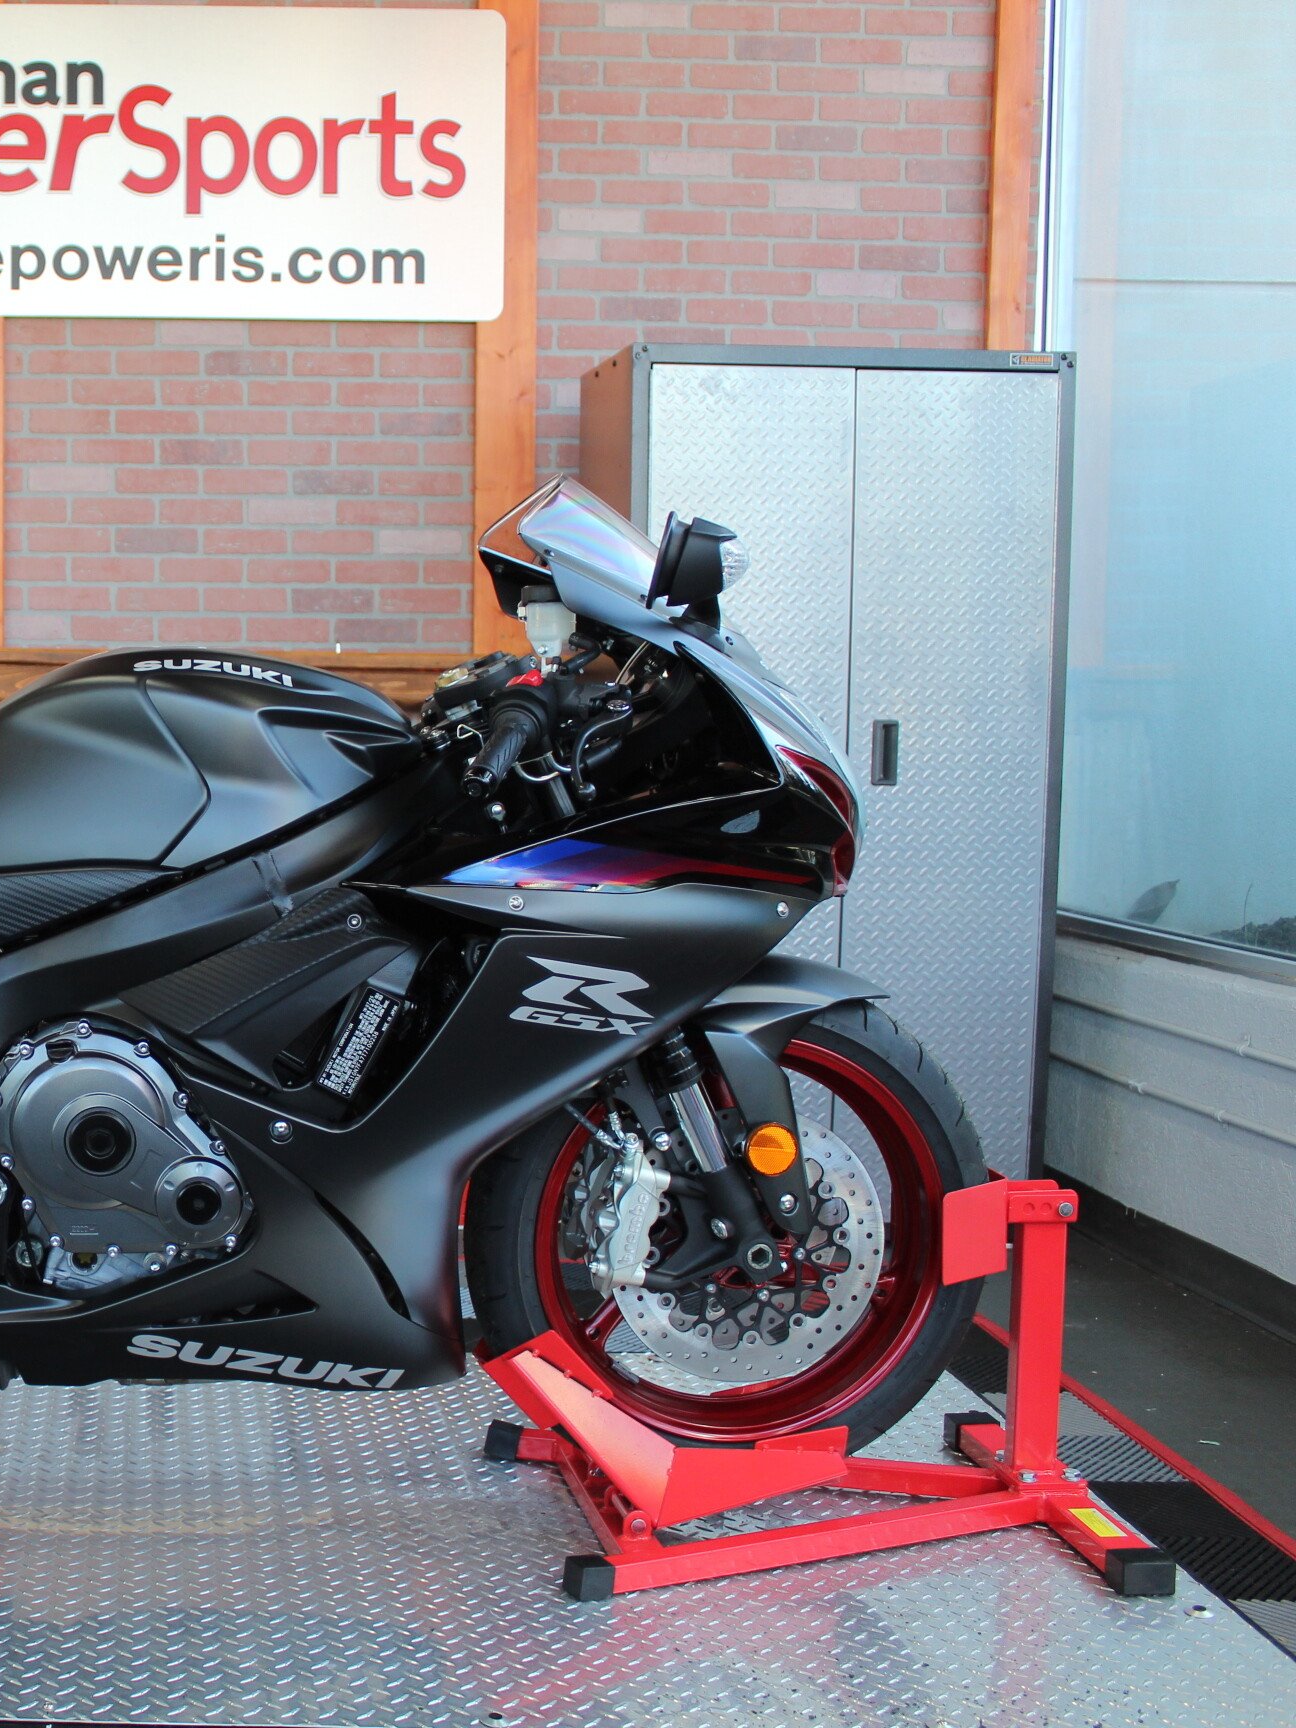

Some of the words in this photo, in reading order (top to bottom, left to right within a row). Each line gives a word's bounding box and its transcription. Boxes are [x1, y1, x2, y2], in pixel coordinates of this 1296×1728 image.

[133, 659, 294, 688] SUZUKI
[521, 955, 655, 1019] R
[509, 1005, 653, 1036] GSX
[126, 1334, 405, 1389] SUZUKI
